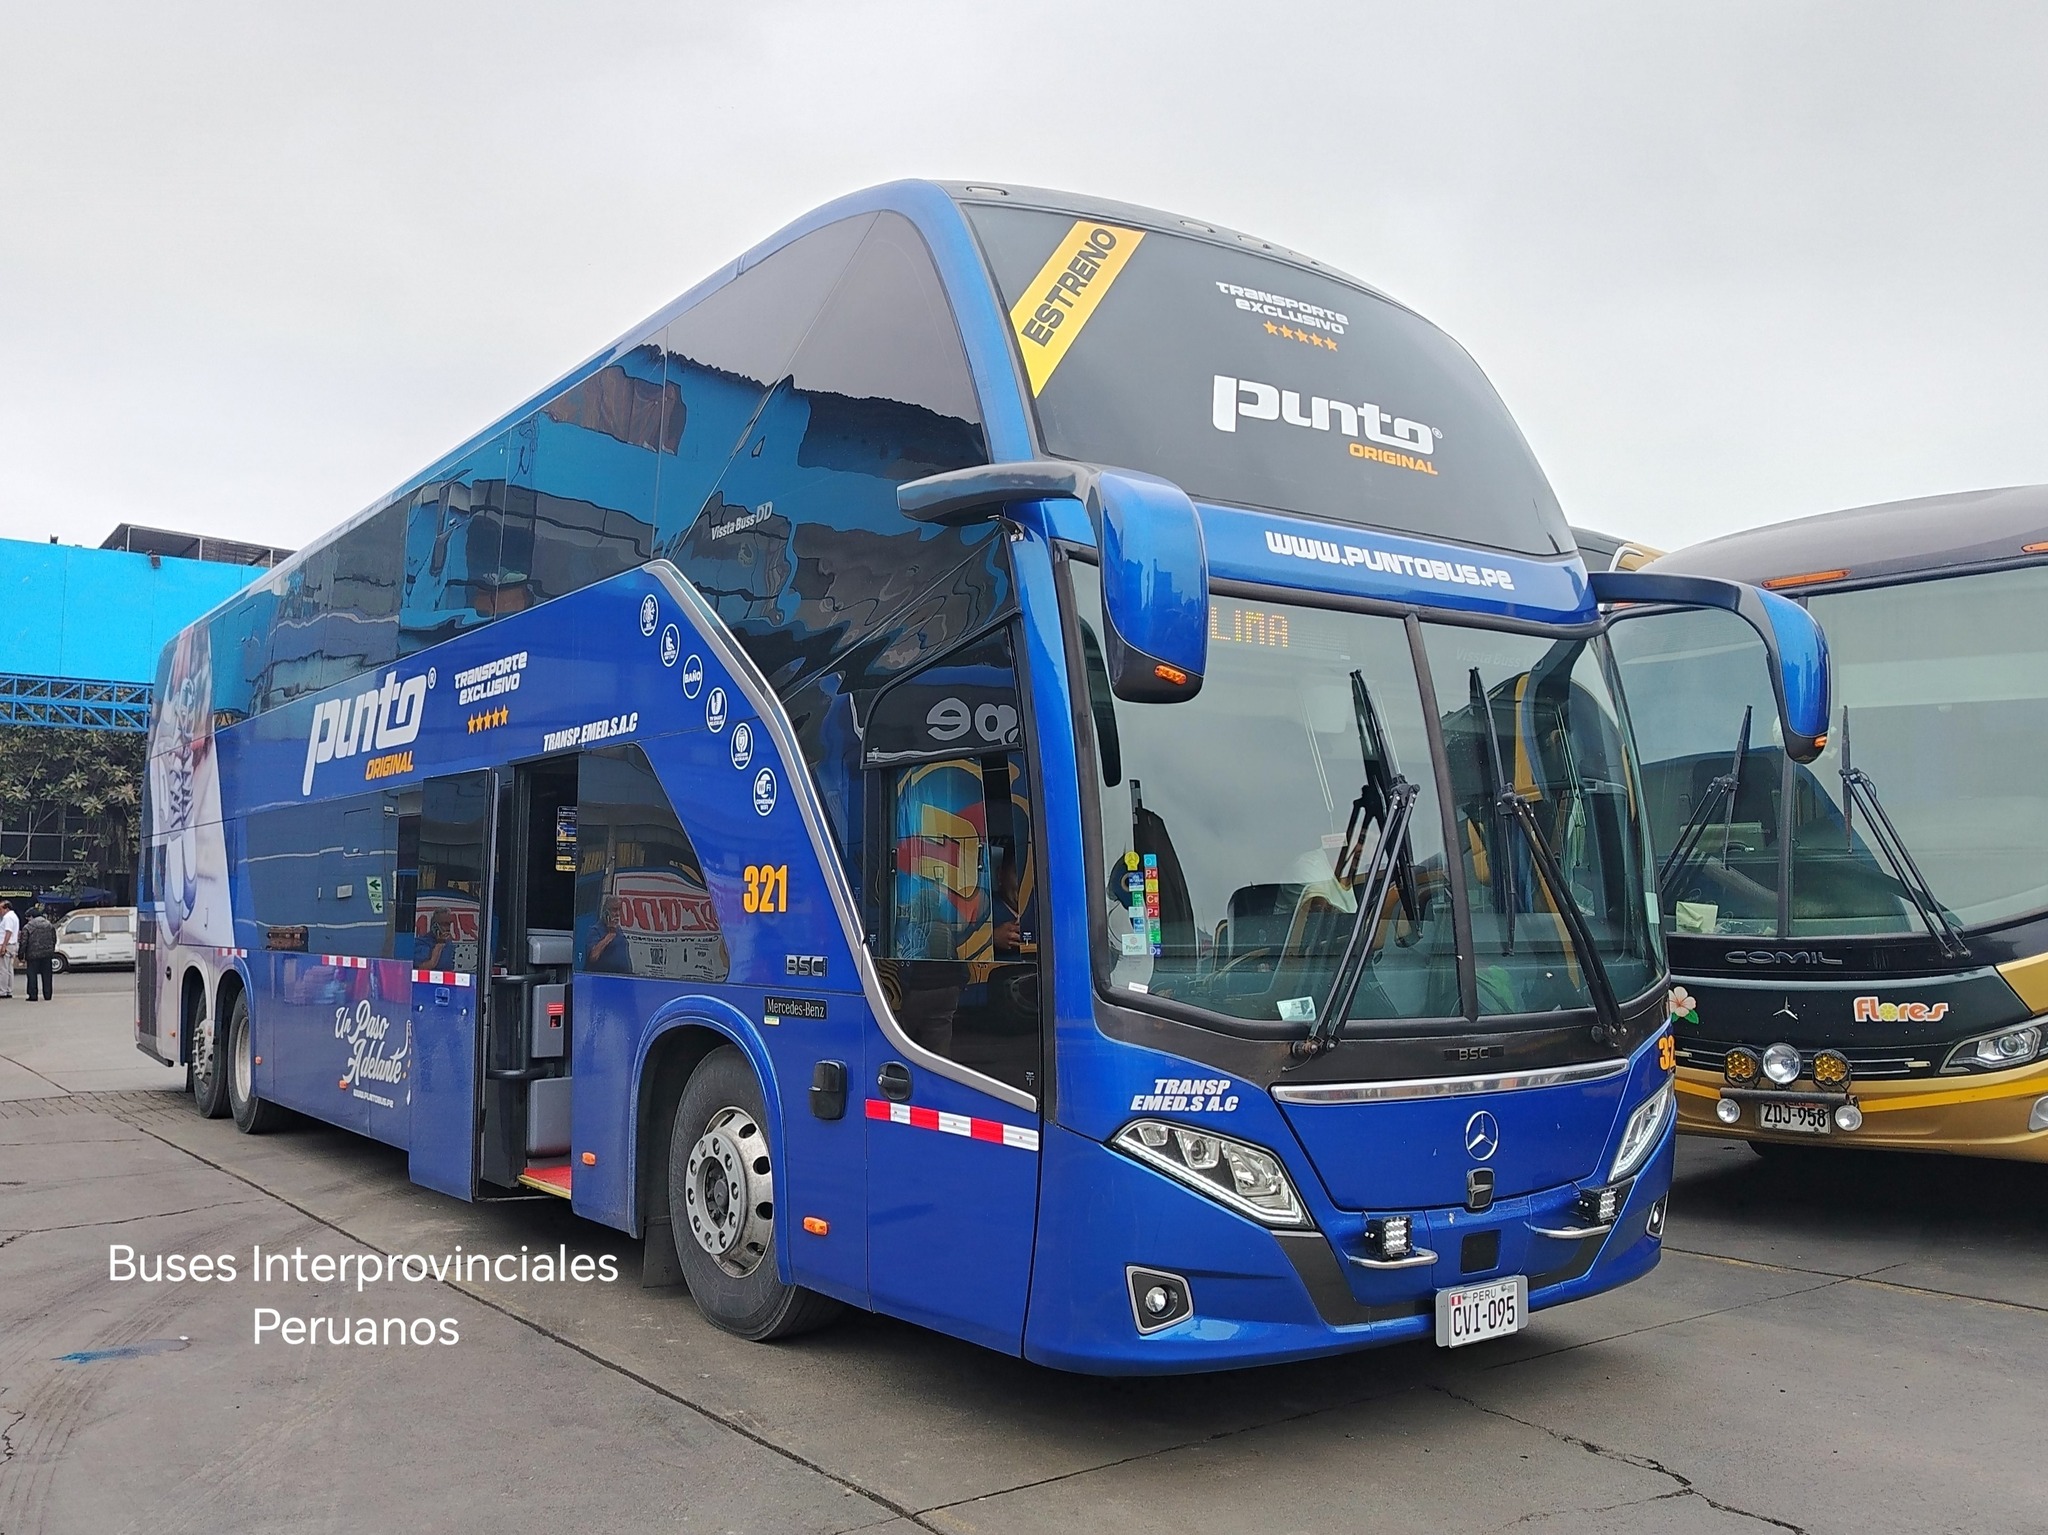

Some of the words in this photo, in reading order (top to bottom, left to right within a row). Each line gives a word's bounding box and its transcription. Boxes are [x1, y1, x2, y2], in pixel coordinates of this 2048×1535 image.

[1021, 228, 1117, 347] ESTRENO
[1349, 442, 1439, 476] ORIGINAL
[711, 520, 735, 541] Vissta
[735, 513, 757, 531] Buss
[755, 501, 773, 524] DD
[1210, 606, 1289, 648] LIMA
[684, 669, 701, 684] BAÑO
[365, 750, 414, 780] ORIGINAL
[743, 864, 788, 913] 321
[786, 955, 824, 977] BSC
[1725, 950, 1843, 965] COMIL
[335, 1007, 352, 1039] Un
[347, 999, 390, 1045] Paso
[767, 998, 825, 1018] Mercedes-Benz
[1854, 996, 1948, 1022] Flores
[342, 1030, 408, 1087] Adelante
[1459, 1047, 1489, 1061] BSC
[1154, 1079, 1231, 1095] TRANSP
[1763, 1103, 1827, 1128] ZDJ-958
[1472, 1288, 1497, 1302] PERU
[1453, 1296, 1515, 1337] CVI-095
